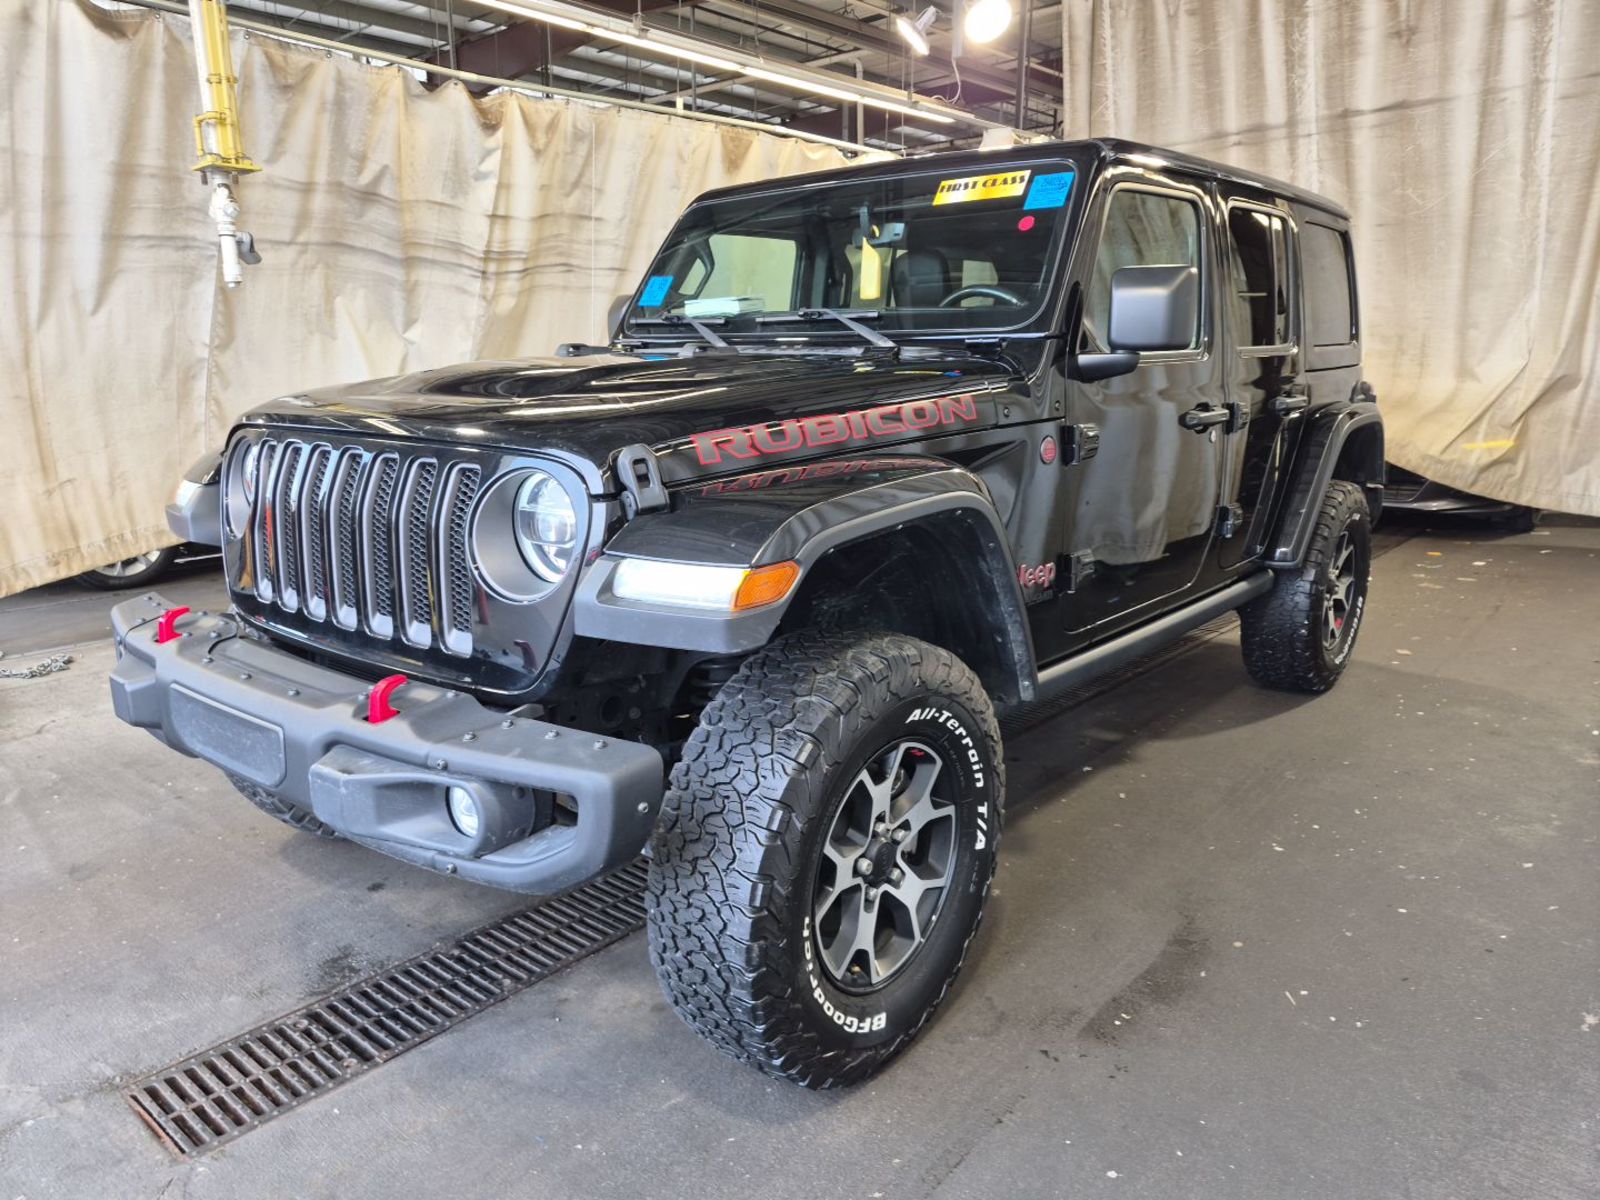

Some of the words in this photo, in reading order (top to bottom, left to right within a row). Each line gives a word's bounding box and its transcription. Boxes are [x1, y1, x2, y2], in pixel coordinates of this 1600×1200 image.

[983, 175, 1025, 188] CLASS
[689, 394, 978, 466] RUBICON
[905, 707, 985, 789] All-Terrain
[974, 800, 988, 851] T/A
[802, 916, 887, 1034] BFGoodrich
